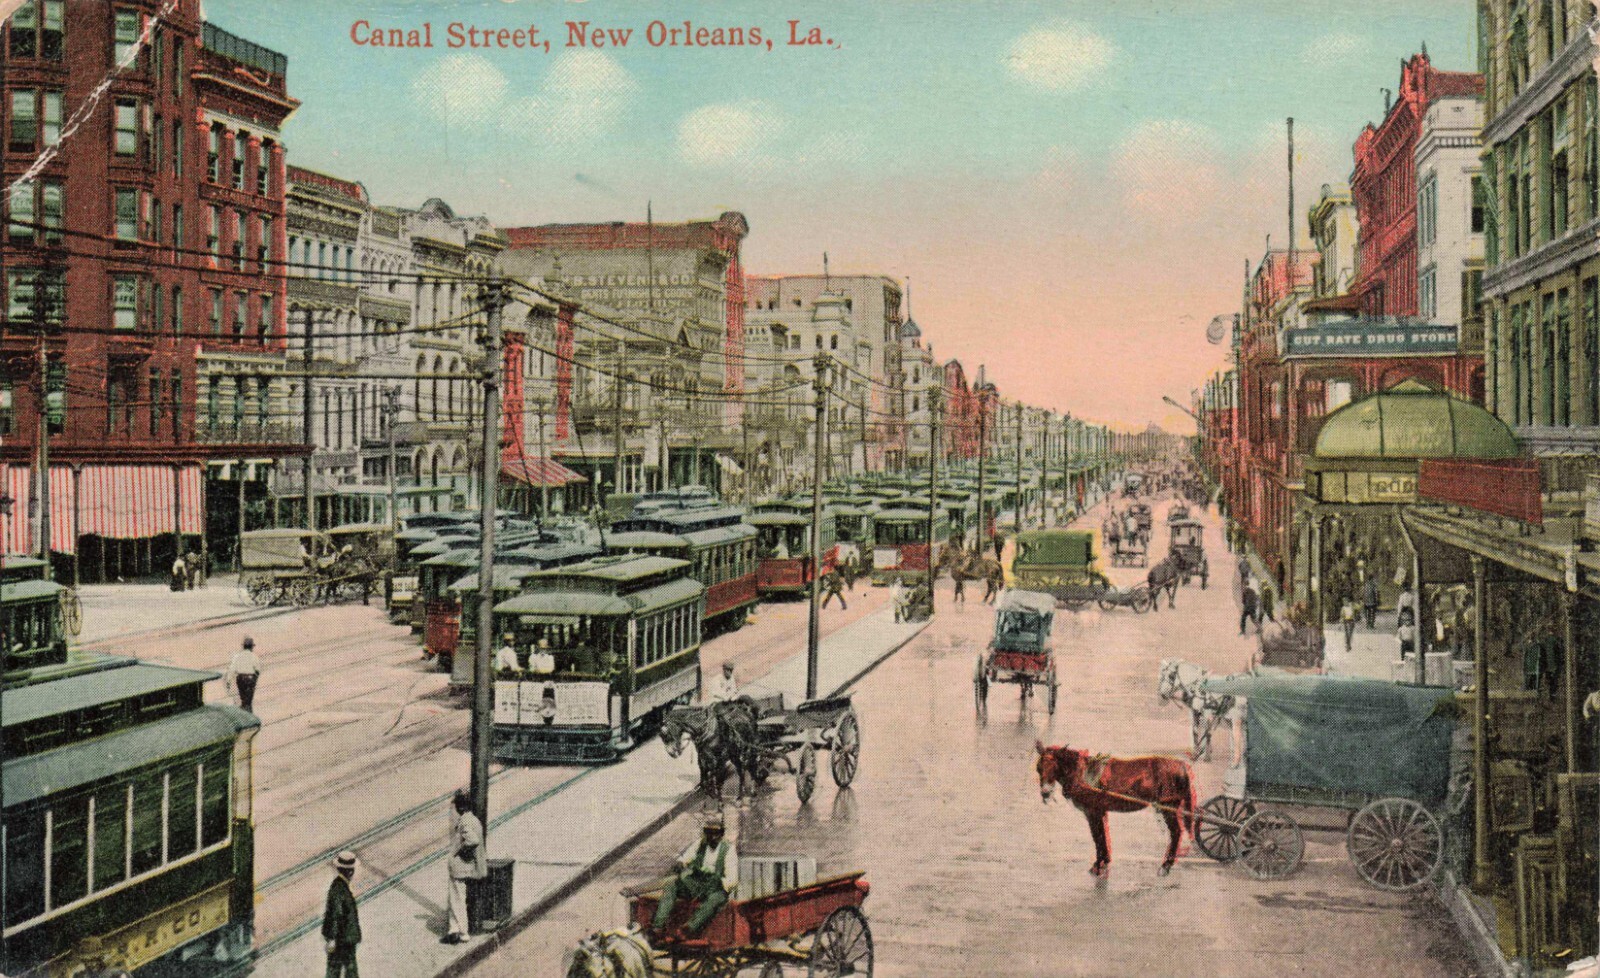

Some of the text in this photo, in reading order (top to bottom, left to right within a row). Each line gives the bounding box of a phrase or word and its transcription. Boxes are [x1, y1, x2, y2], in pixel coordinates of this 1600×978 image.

[1293, 332, 1456, 345] CUT RATE DRUG STORE
